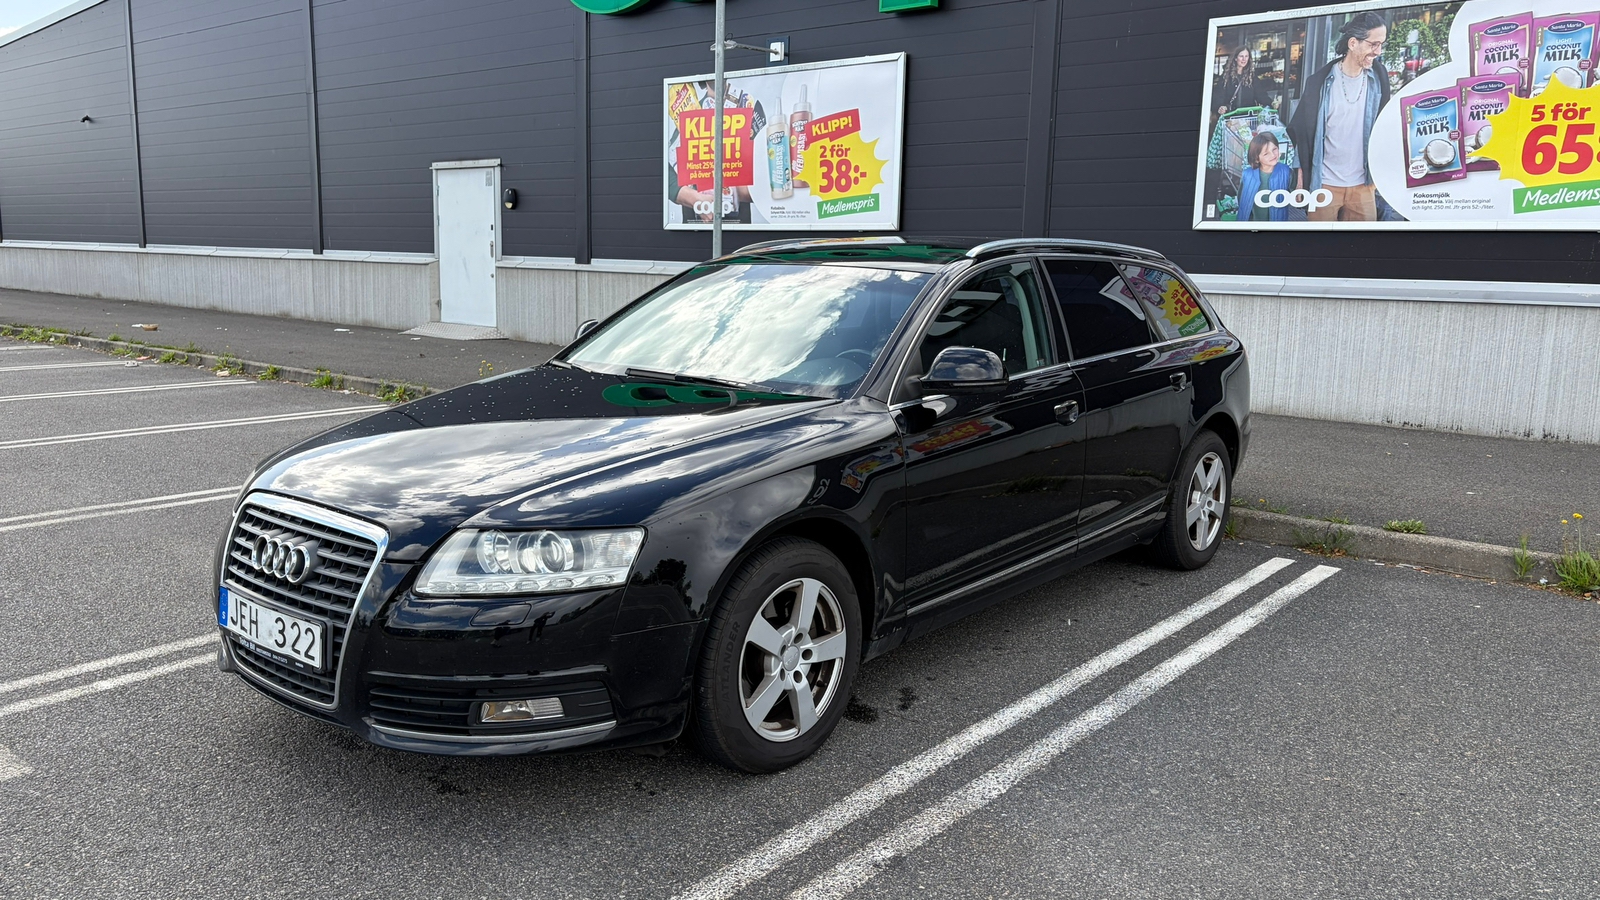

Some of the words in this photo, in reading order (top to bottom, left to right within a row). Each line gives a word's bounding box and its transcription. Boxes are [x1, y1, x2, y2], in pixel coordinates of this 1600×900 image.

[1484, 43, 1519, 54] COCONUT
[1546, 42, 1582, 51] COCONUT
[1483, 49, 1519, 65] MILK
[1543, 48, 1582, 62] MILK
[1470, 103, 1504, 111] COCONUT
[1531, 104, 1546, 122] 5
[1551, 102, 1592, 121] för
[811, 115, 853, 137] KLIPP!
[1416, 116, 1449, 127] COCONUT
[1415, 121, 1450, 138] MILK
[819, 145, 827, 159] 2
[829, 144, 851, 158] för
[686, 162, 702, 170] Minst
[731, 160, 743, 170] pris
[689, 171, 698, 180] på
[698, 170, 711, 178] över
[819, 158, 867, 194] 38:-
[1254, 188, 1333, 213] coop
[1522, 187, 1600, 208] Medlems
[822, 196, 875, 215] Medlemspris
[221, 610, 227, 620] S
[230, 598, 259, 640] JEH
[274, 616, 316, 662] 322
